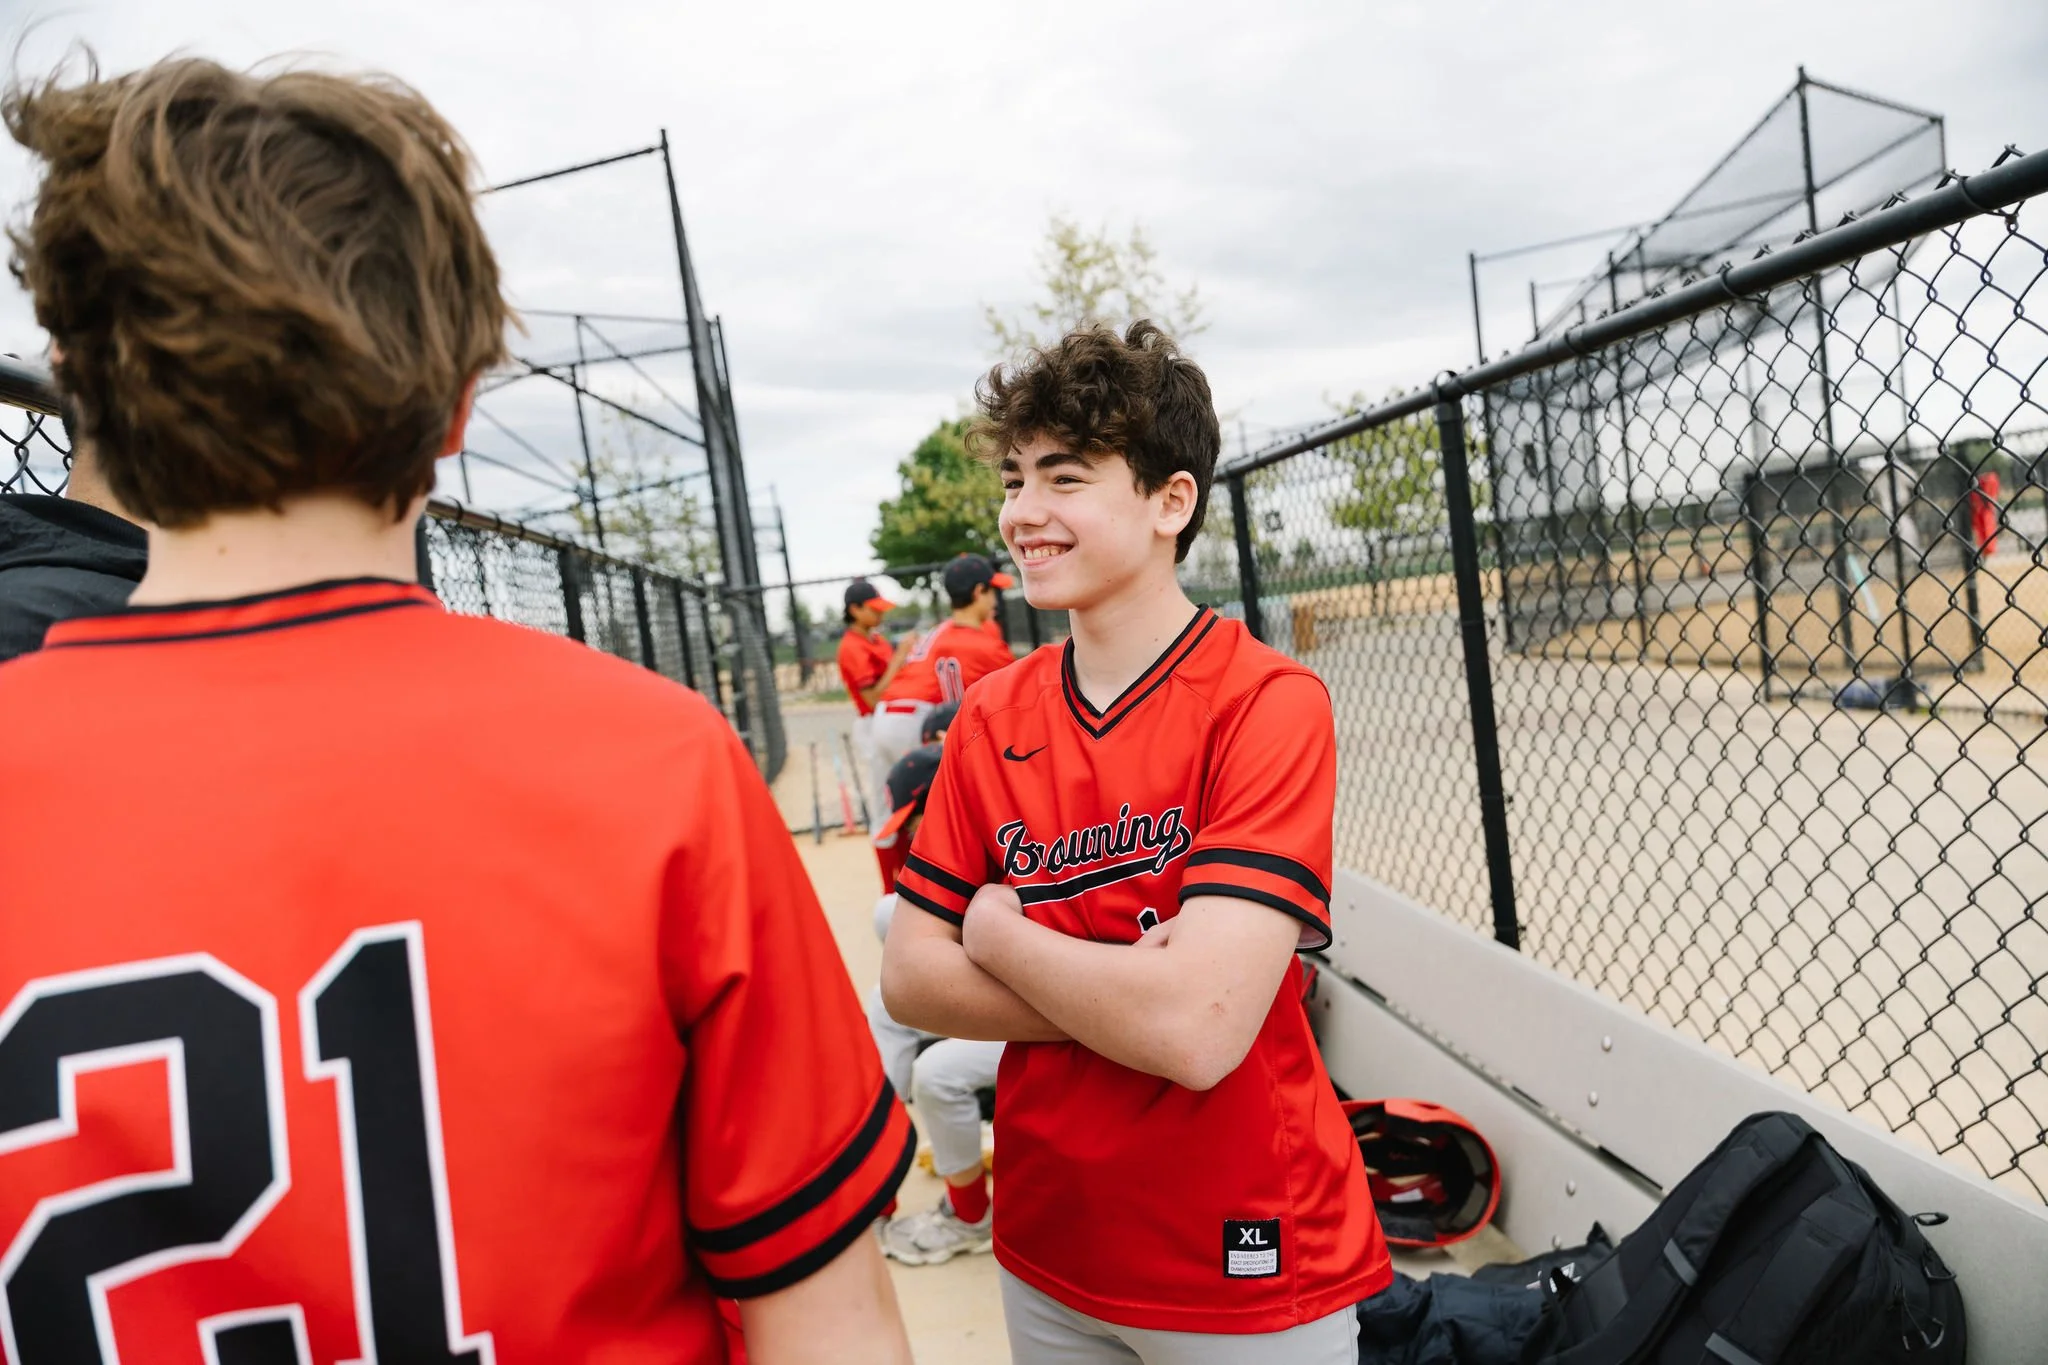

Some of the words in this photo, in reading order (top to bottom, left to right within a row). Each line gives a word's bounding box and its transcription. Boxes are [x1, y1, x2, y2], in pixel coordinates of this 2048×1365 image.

[996, 802, 1192, 877] Browning
[0, 920, 495, 1365] 21
[1239, 1228, 1268, 1245] XL
